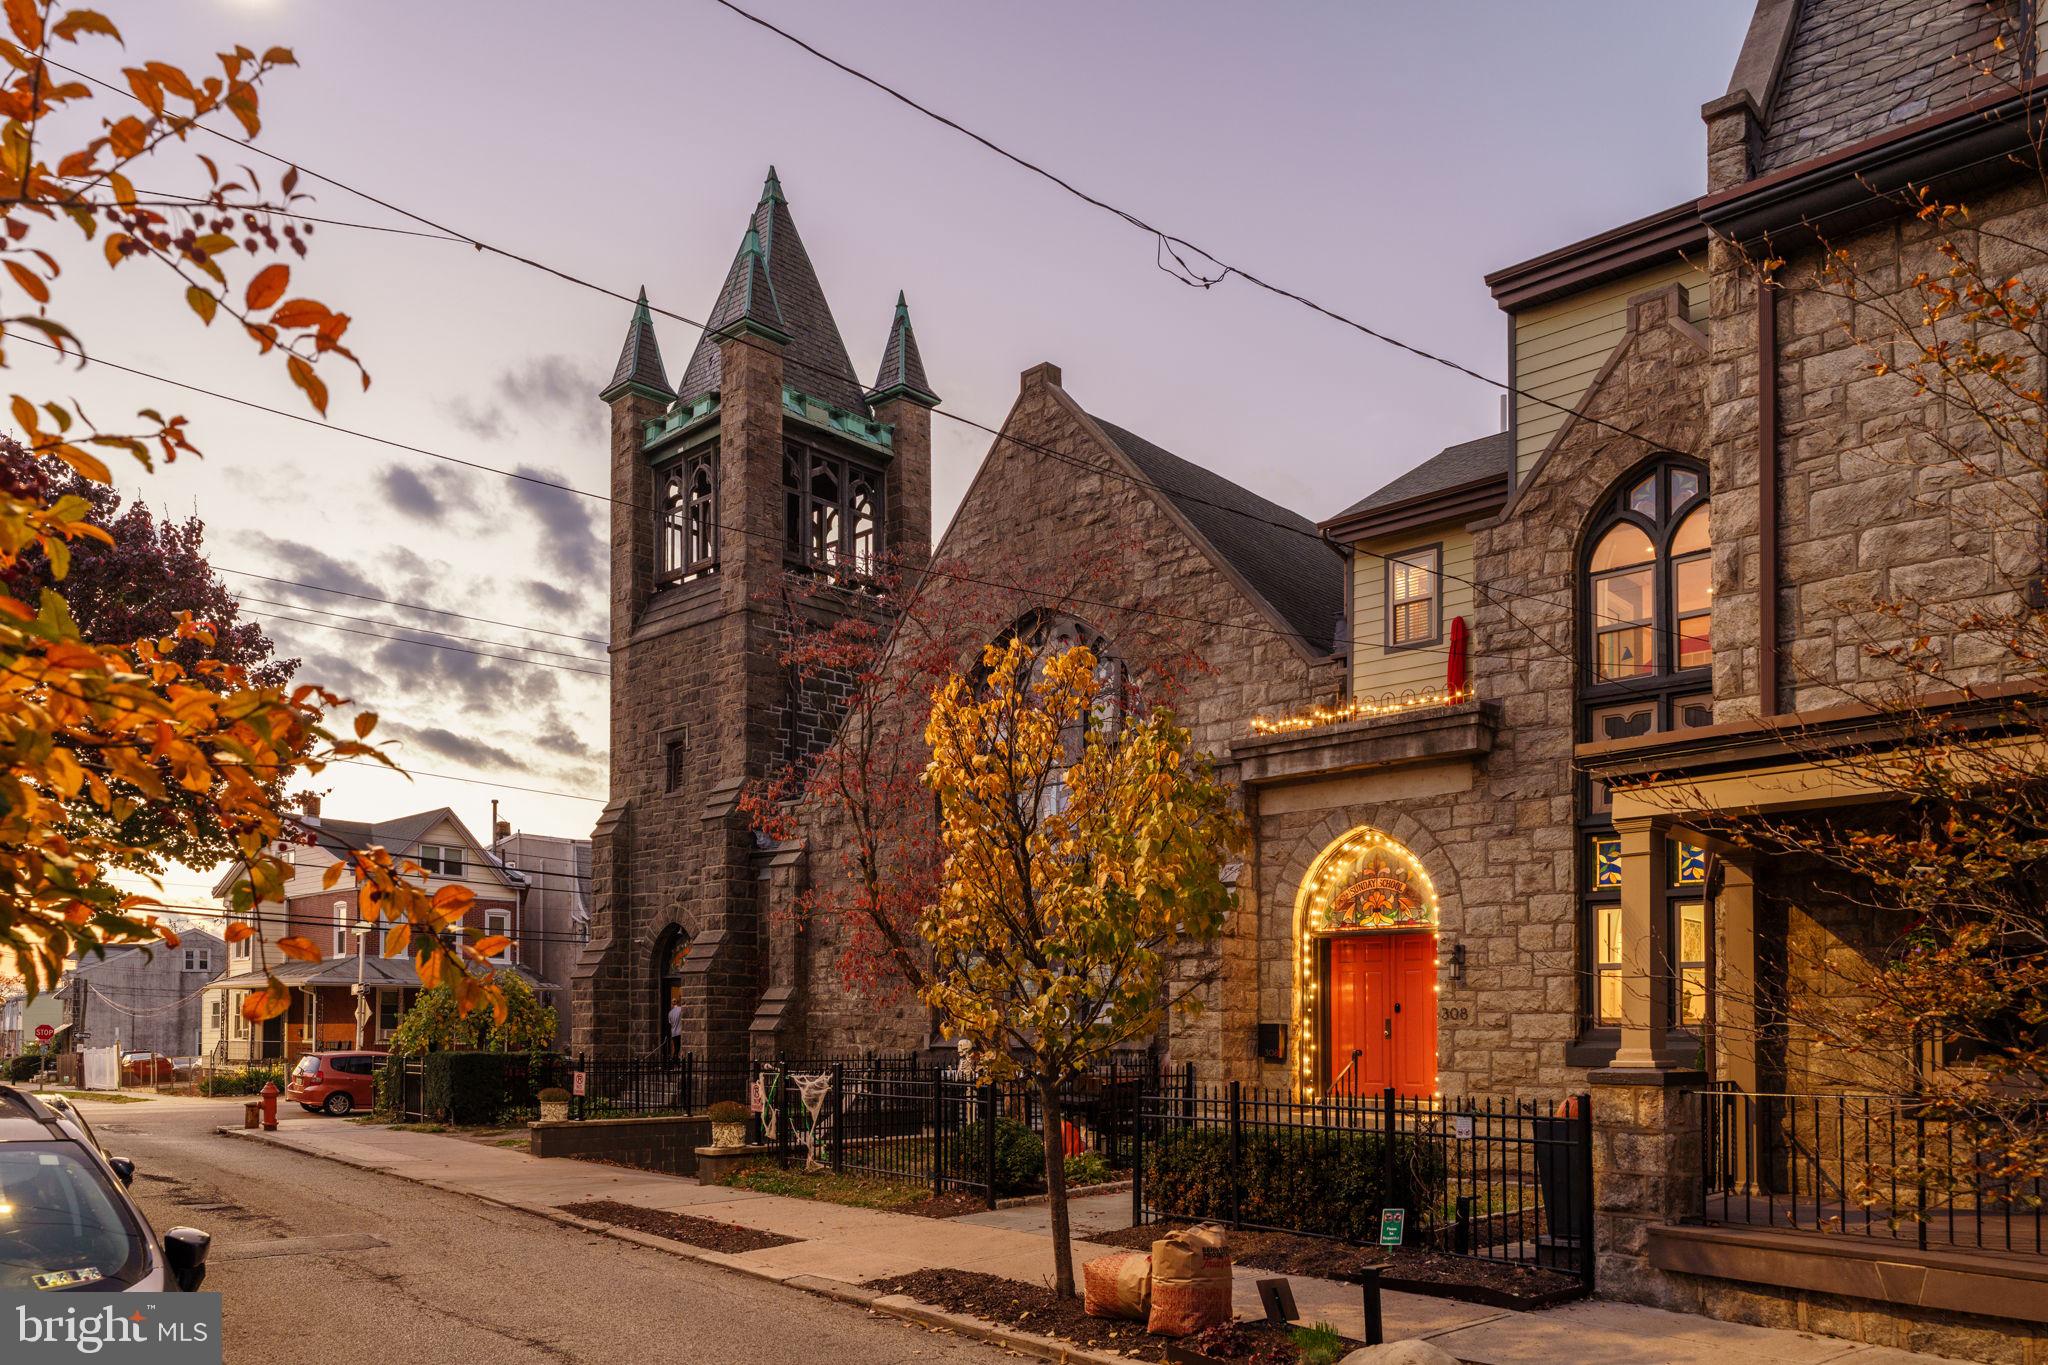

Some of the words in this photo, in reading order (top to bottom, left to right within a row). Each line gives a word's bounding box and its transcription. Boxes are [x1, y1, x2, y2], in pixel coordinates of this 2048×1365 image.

[1350, 880, 1376, 895] SUNDAY
[1379, 879, 1403, 892] SCHOOL
[1441, 1007, 1468, 1020] 308
